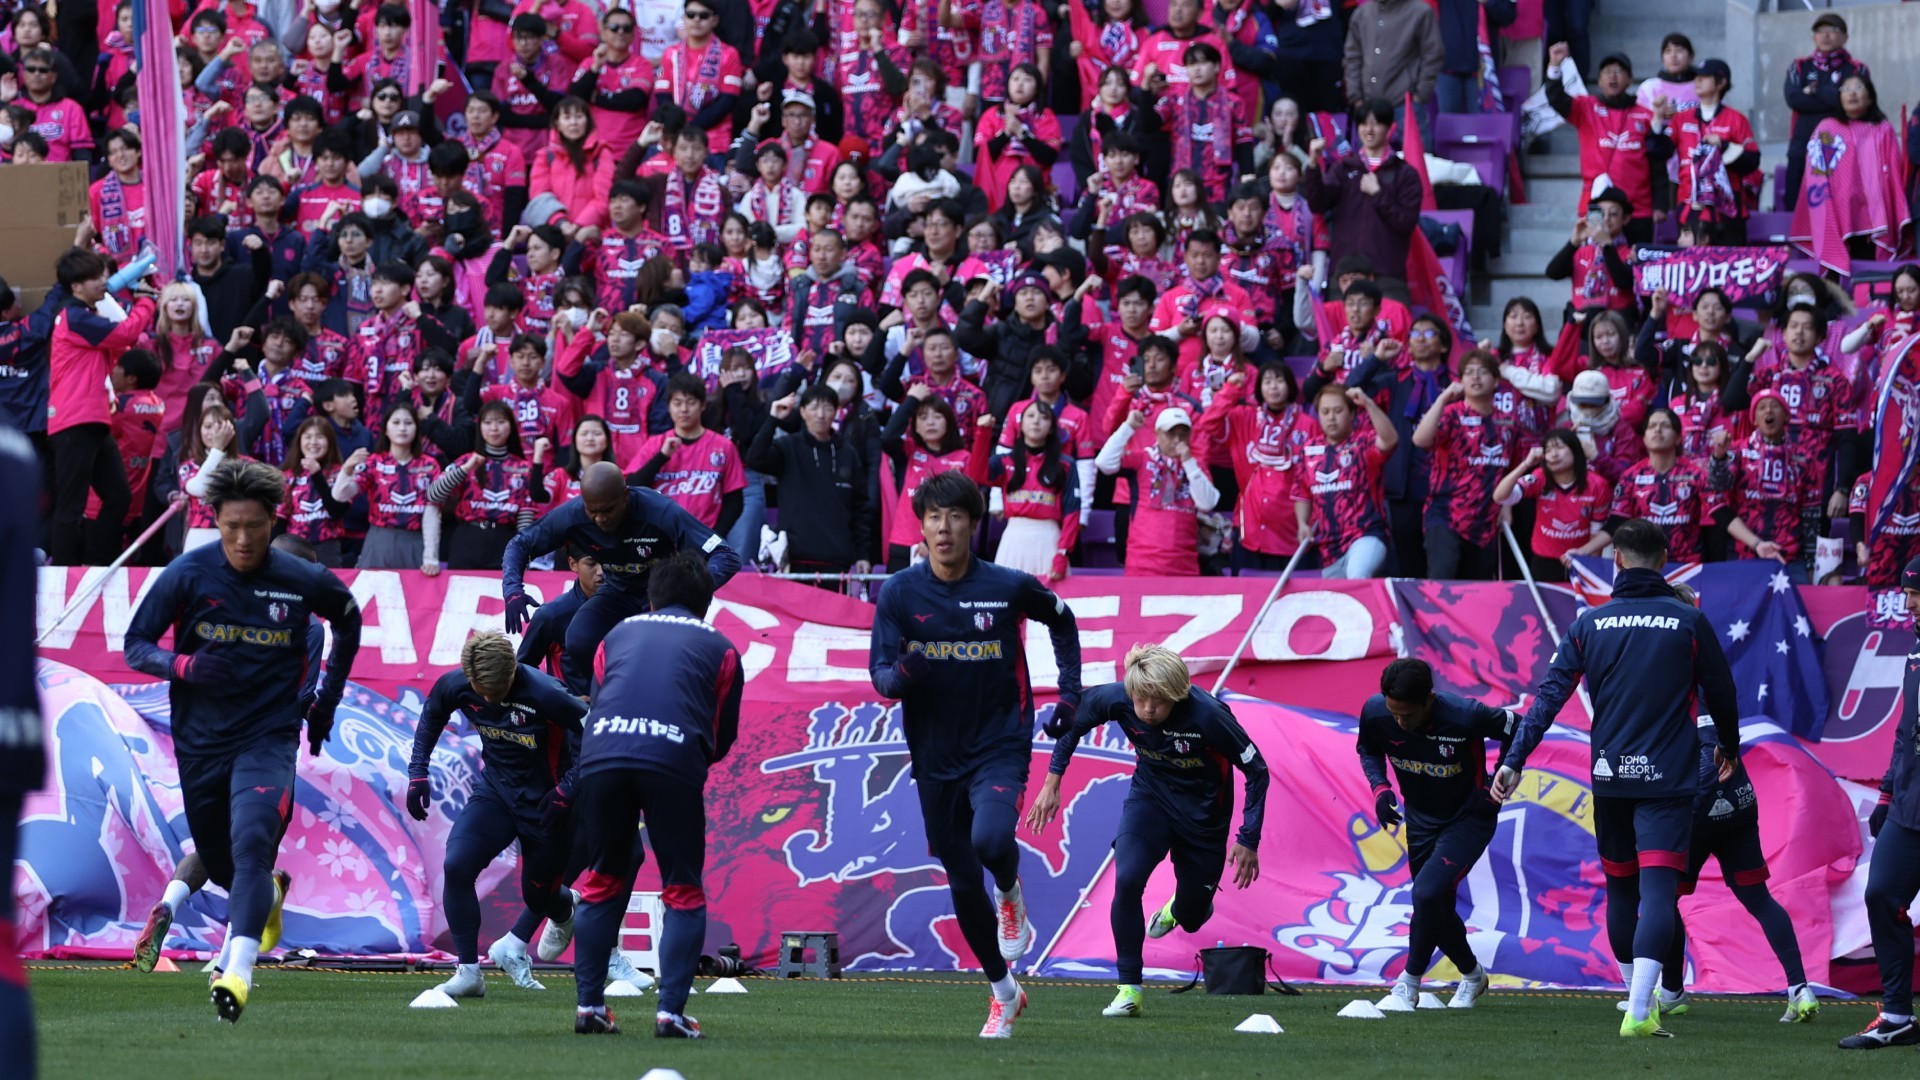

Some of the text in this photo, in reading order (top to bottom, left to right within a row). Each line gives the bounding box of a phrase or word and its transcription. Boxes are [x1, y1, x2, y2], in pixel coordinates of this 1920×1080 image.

[613, 386, 628, 411] 8
[1259, 424, 1282, 446] 12
[1762, 458, 1784, 482] 16
[268, 590, 303, 602] YANMAR
[973, 601, 1008, 609] YANMAR
[1593, 614, 1680, 631] YANMAR
[195, 622, 292, 646] CAPCOM
[700, 590, 1375, 690] CEEZO
[908, 640, 1003, 661] CAPCOM
[477, 725, 538, 749] APCOM
[593, 715, 684, 743] ナカバヤシ
[1618, 765, 1656, 774] RESORT
[1619, 755, 1648, 765] TOHO
